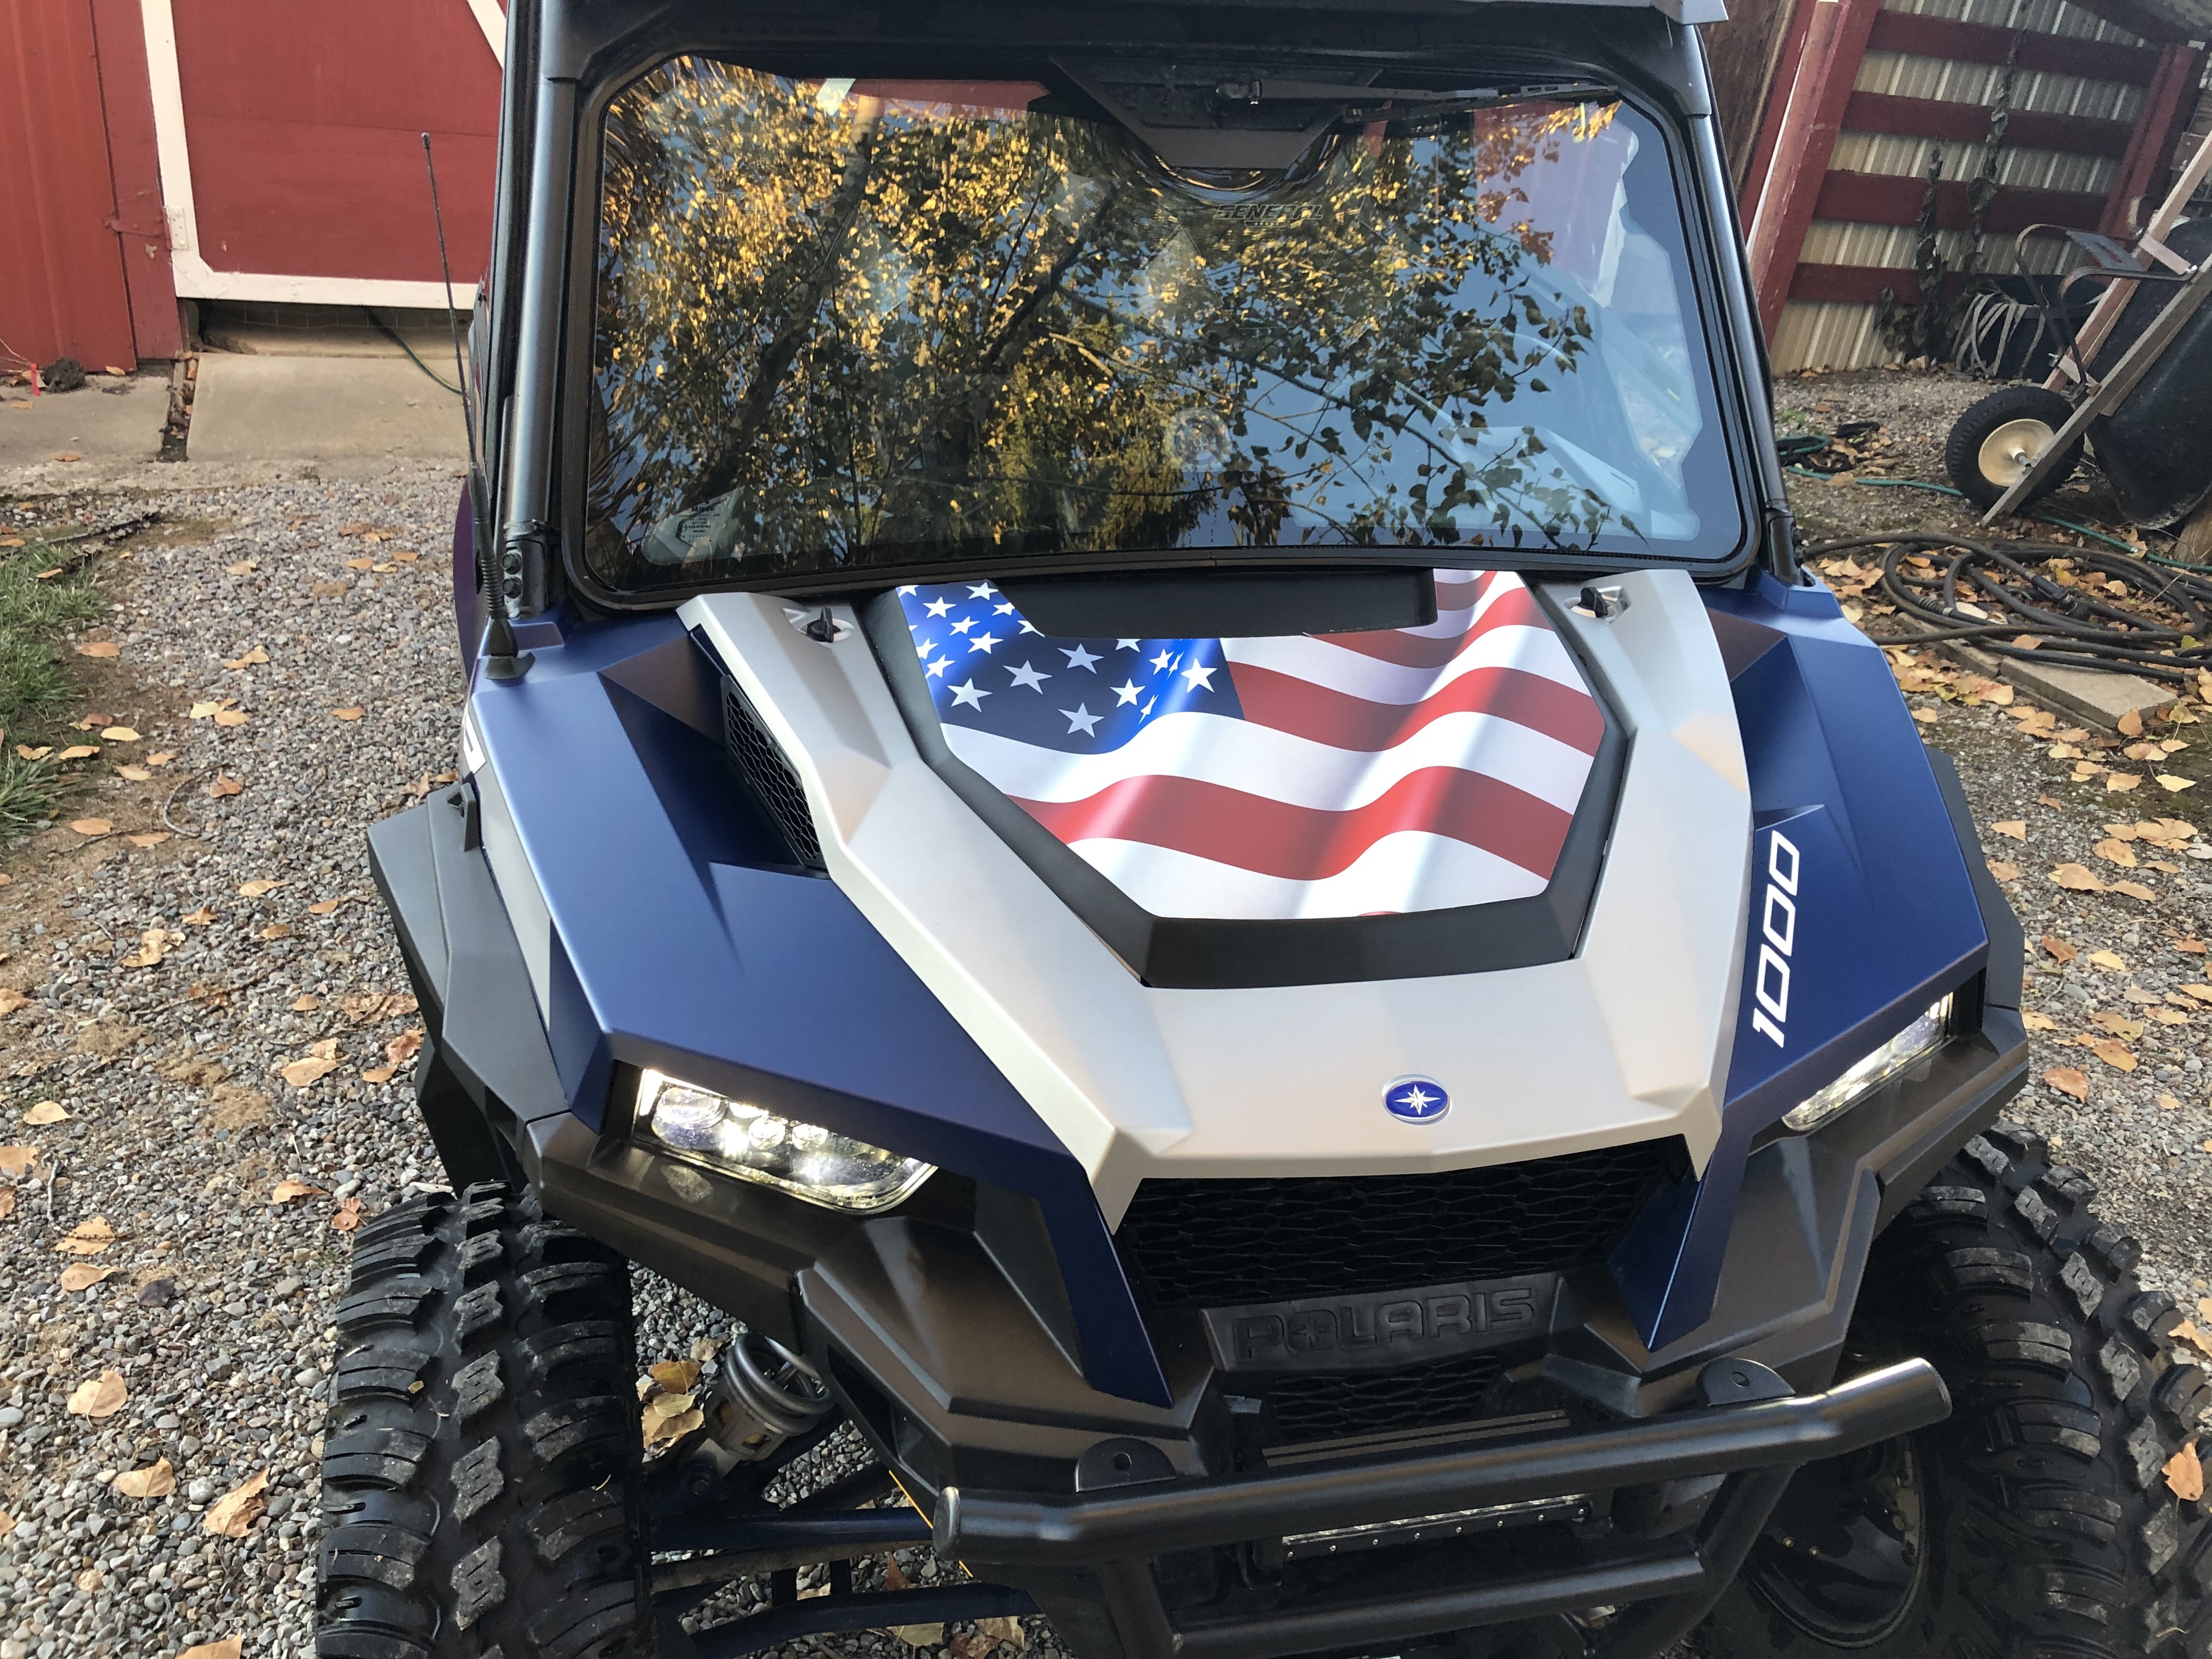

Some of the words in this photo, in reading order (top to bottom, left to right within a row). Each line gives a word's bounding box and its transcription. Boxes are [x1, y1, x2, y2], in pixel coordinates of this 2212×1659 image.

[1213, 204, 1324, 219] GENERAL
[1753, 830, 1799, 1048] 1000
[1233, 1288, 1534, 1362] POLARIS
